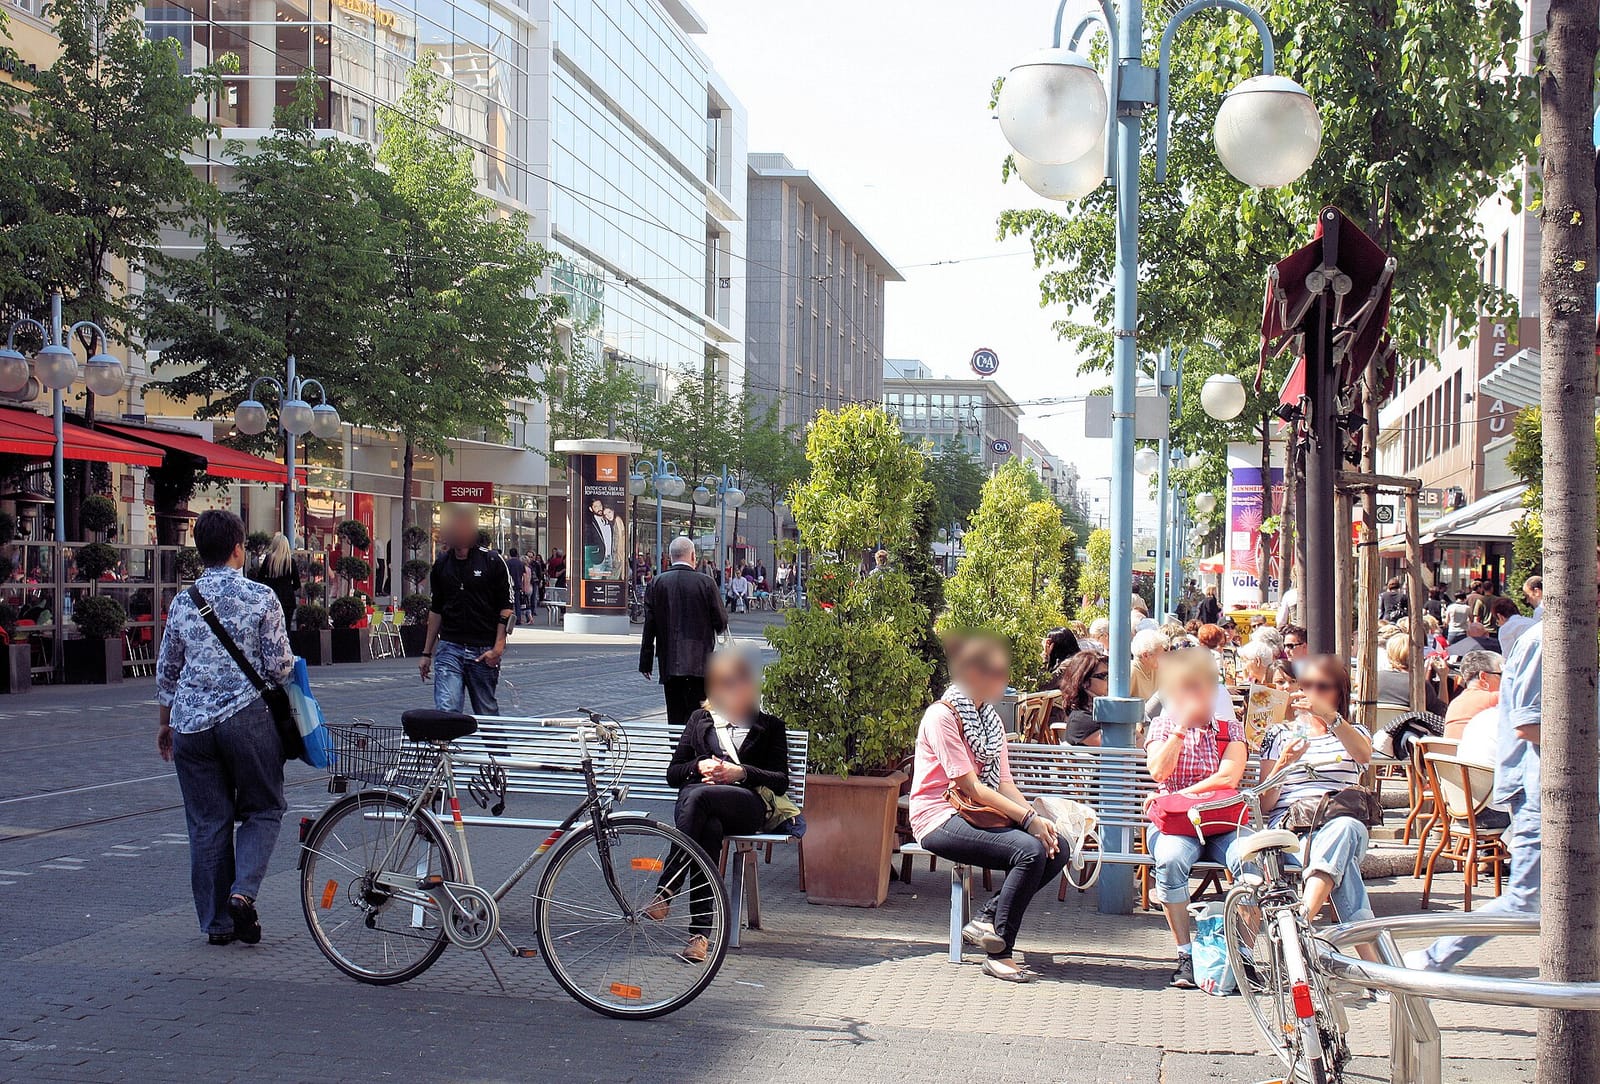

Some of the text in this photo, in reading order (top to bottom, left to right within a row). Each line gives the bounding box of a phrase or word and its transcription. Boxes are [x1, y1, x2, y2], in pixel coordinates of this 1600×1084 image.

[976, 354, 994, 369] C&A
[1489, 323, 1506, 442] REAU
[994, 443, 1008, 452] C&A
[451, 486, 484, 497] ESPRIT
